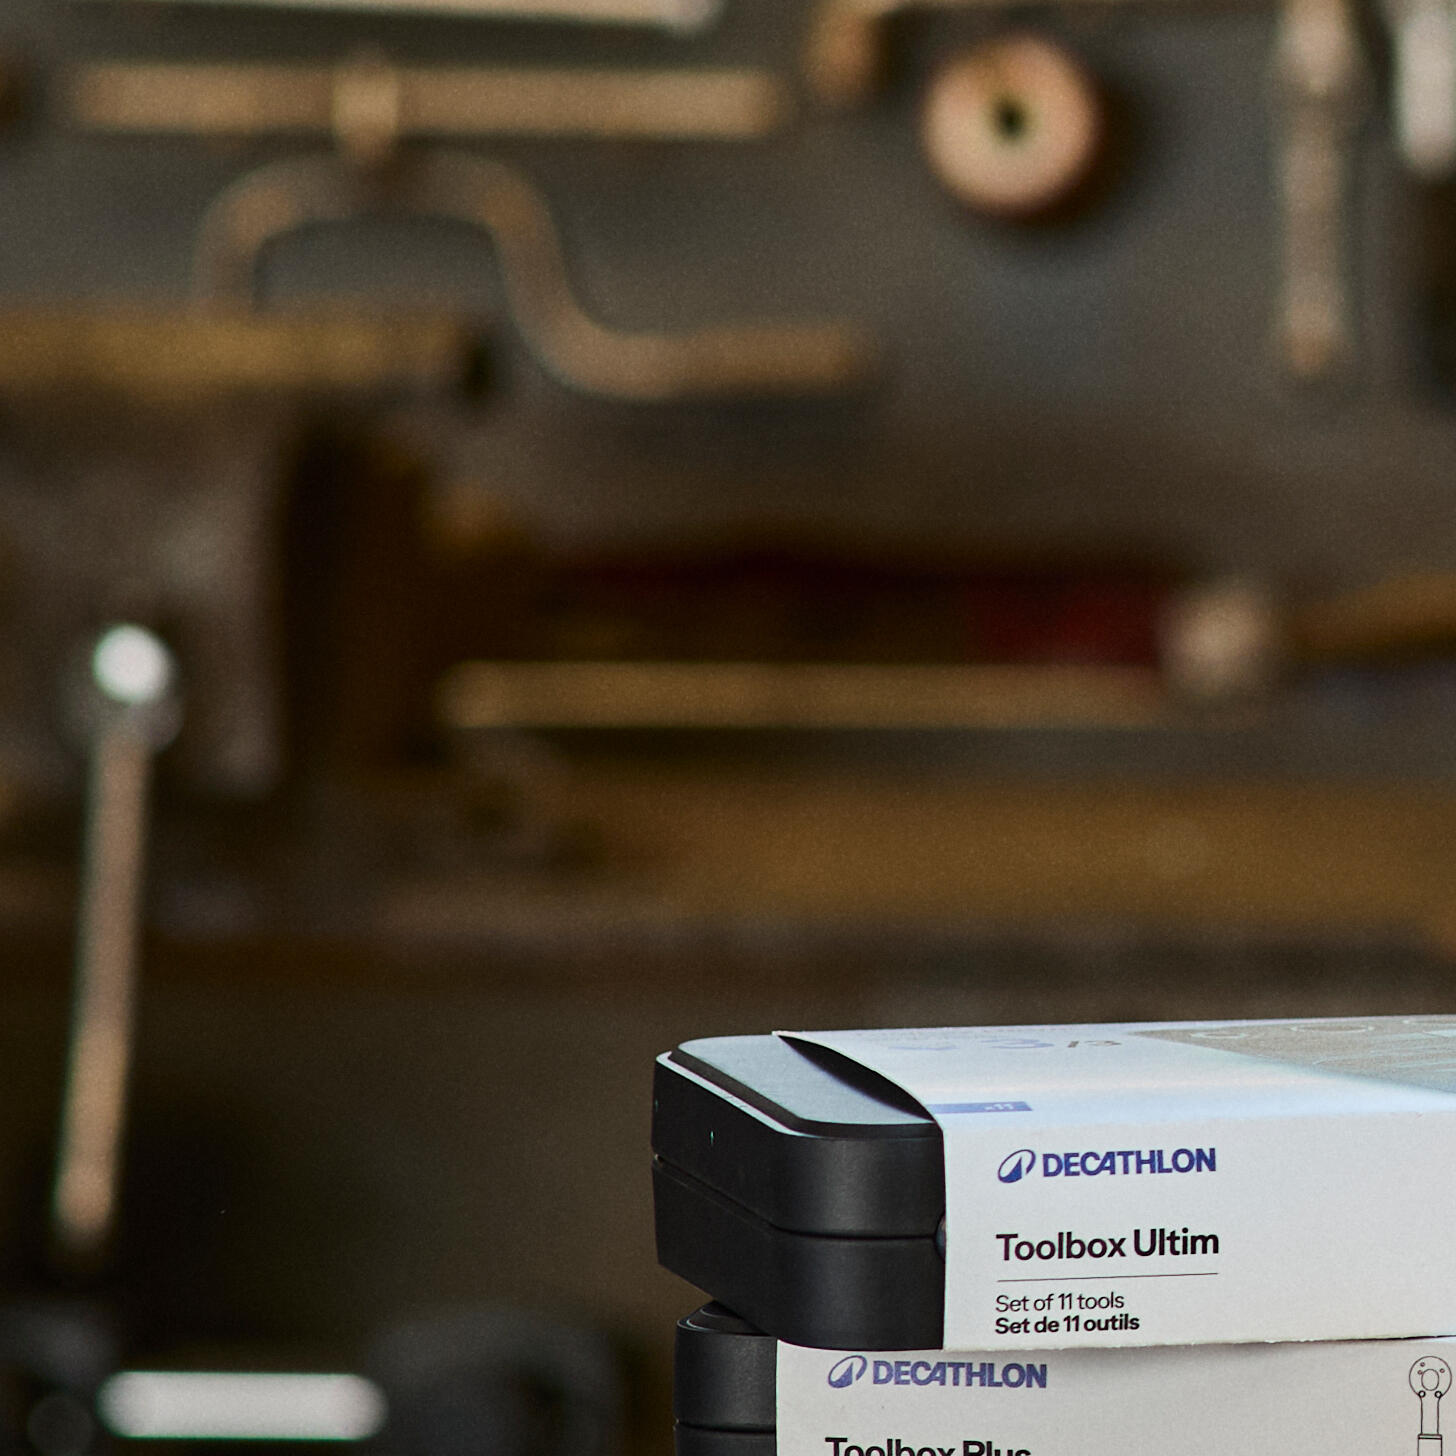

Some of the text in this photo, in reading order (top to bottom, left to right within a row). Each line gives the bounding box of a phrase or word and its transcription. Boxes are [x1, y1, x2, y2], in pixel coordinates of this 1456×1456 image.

[1042, 1147, 1217, 1178] DECATHLON
[995, 1226, 1220, 1261] Toolbox Ultim
[995, 1291, 1125, 1313] Set of 11 tools
[994, 1312, 1141, 1335] Set de 11 outils
[873, 1360, 1048, 1389] DECATHLON
